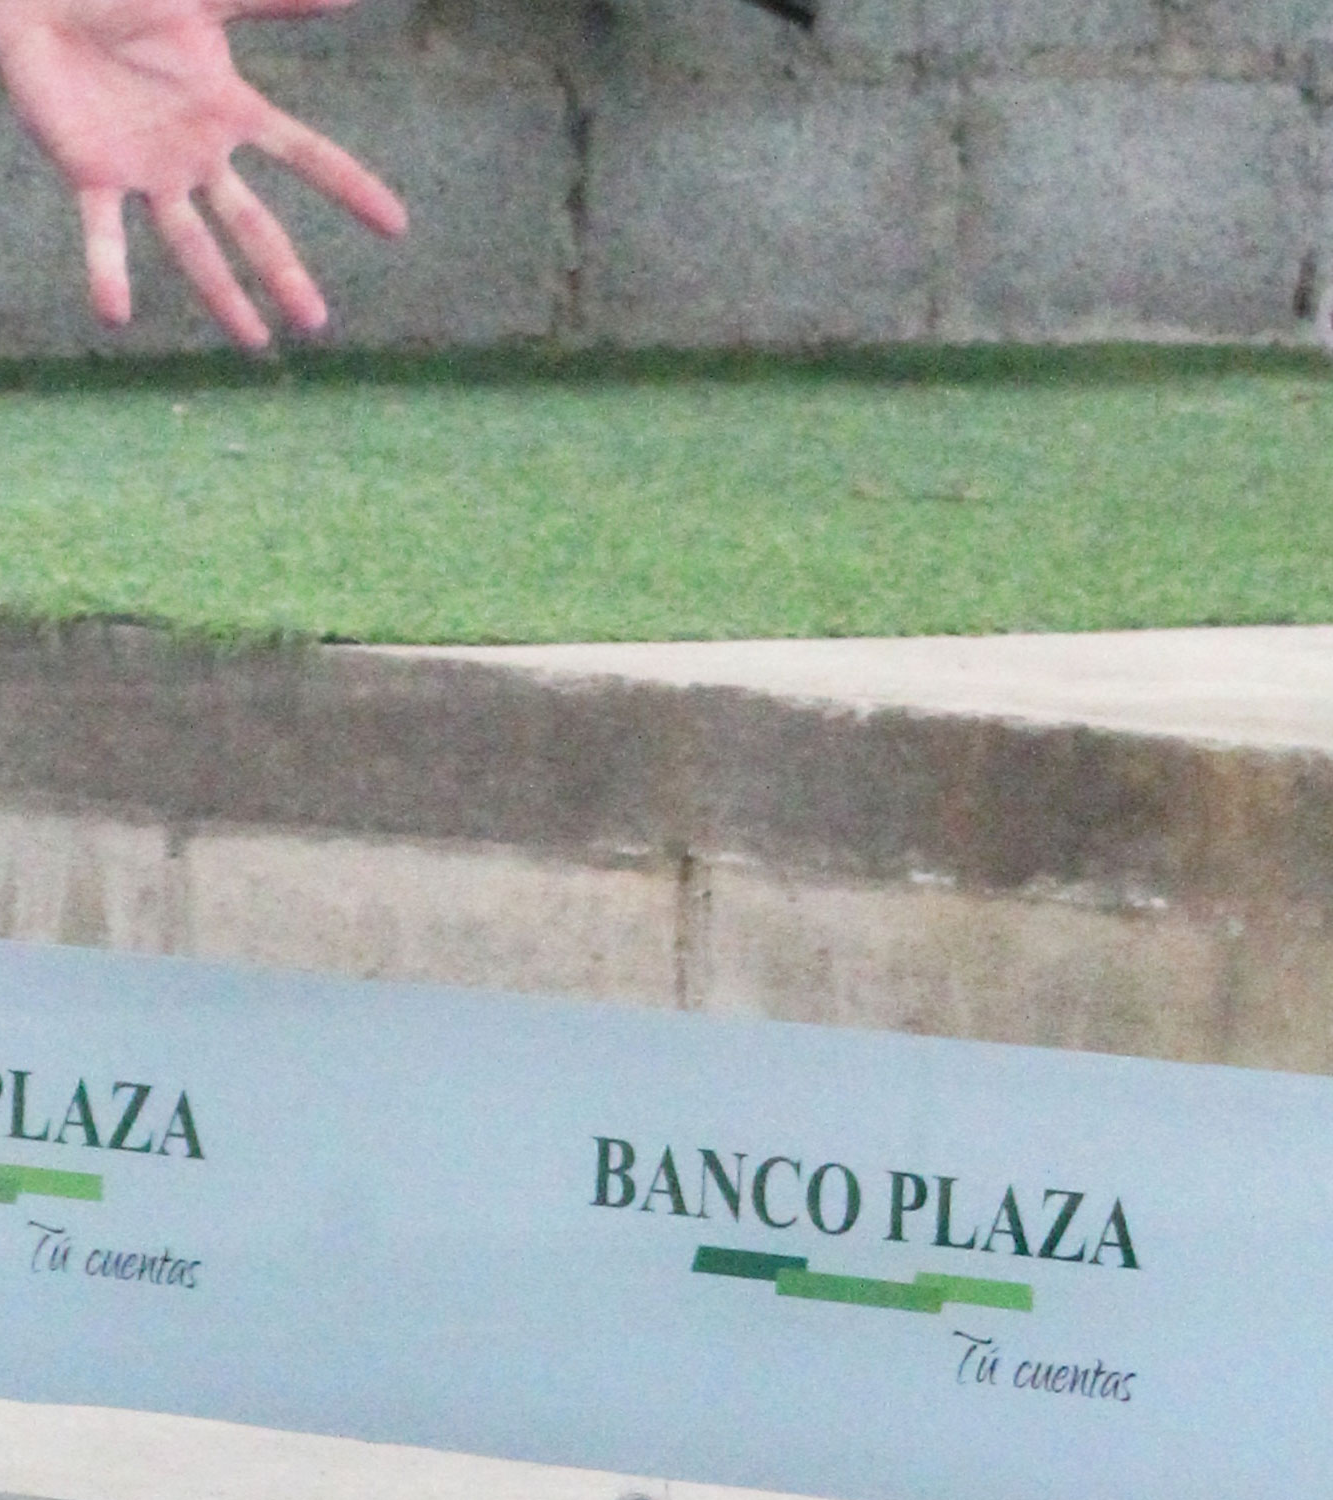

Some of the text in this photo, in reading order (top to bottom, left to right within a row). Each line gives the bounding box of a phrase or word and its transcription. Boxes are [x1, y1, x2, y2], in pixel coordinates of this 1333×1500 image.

[590, 1135, 1141, 1270] BANCO PLAZA
[84, 1247, 202, 1289] cuentas
[1012, 1357, 1137, 1402] cuentas
